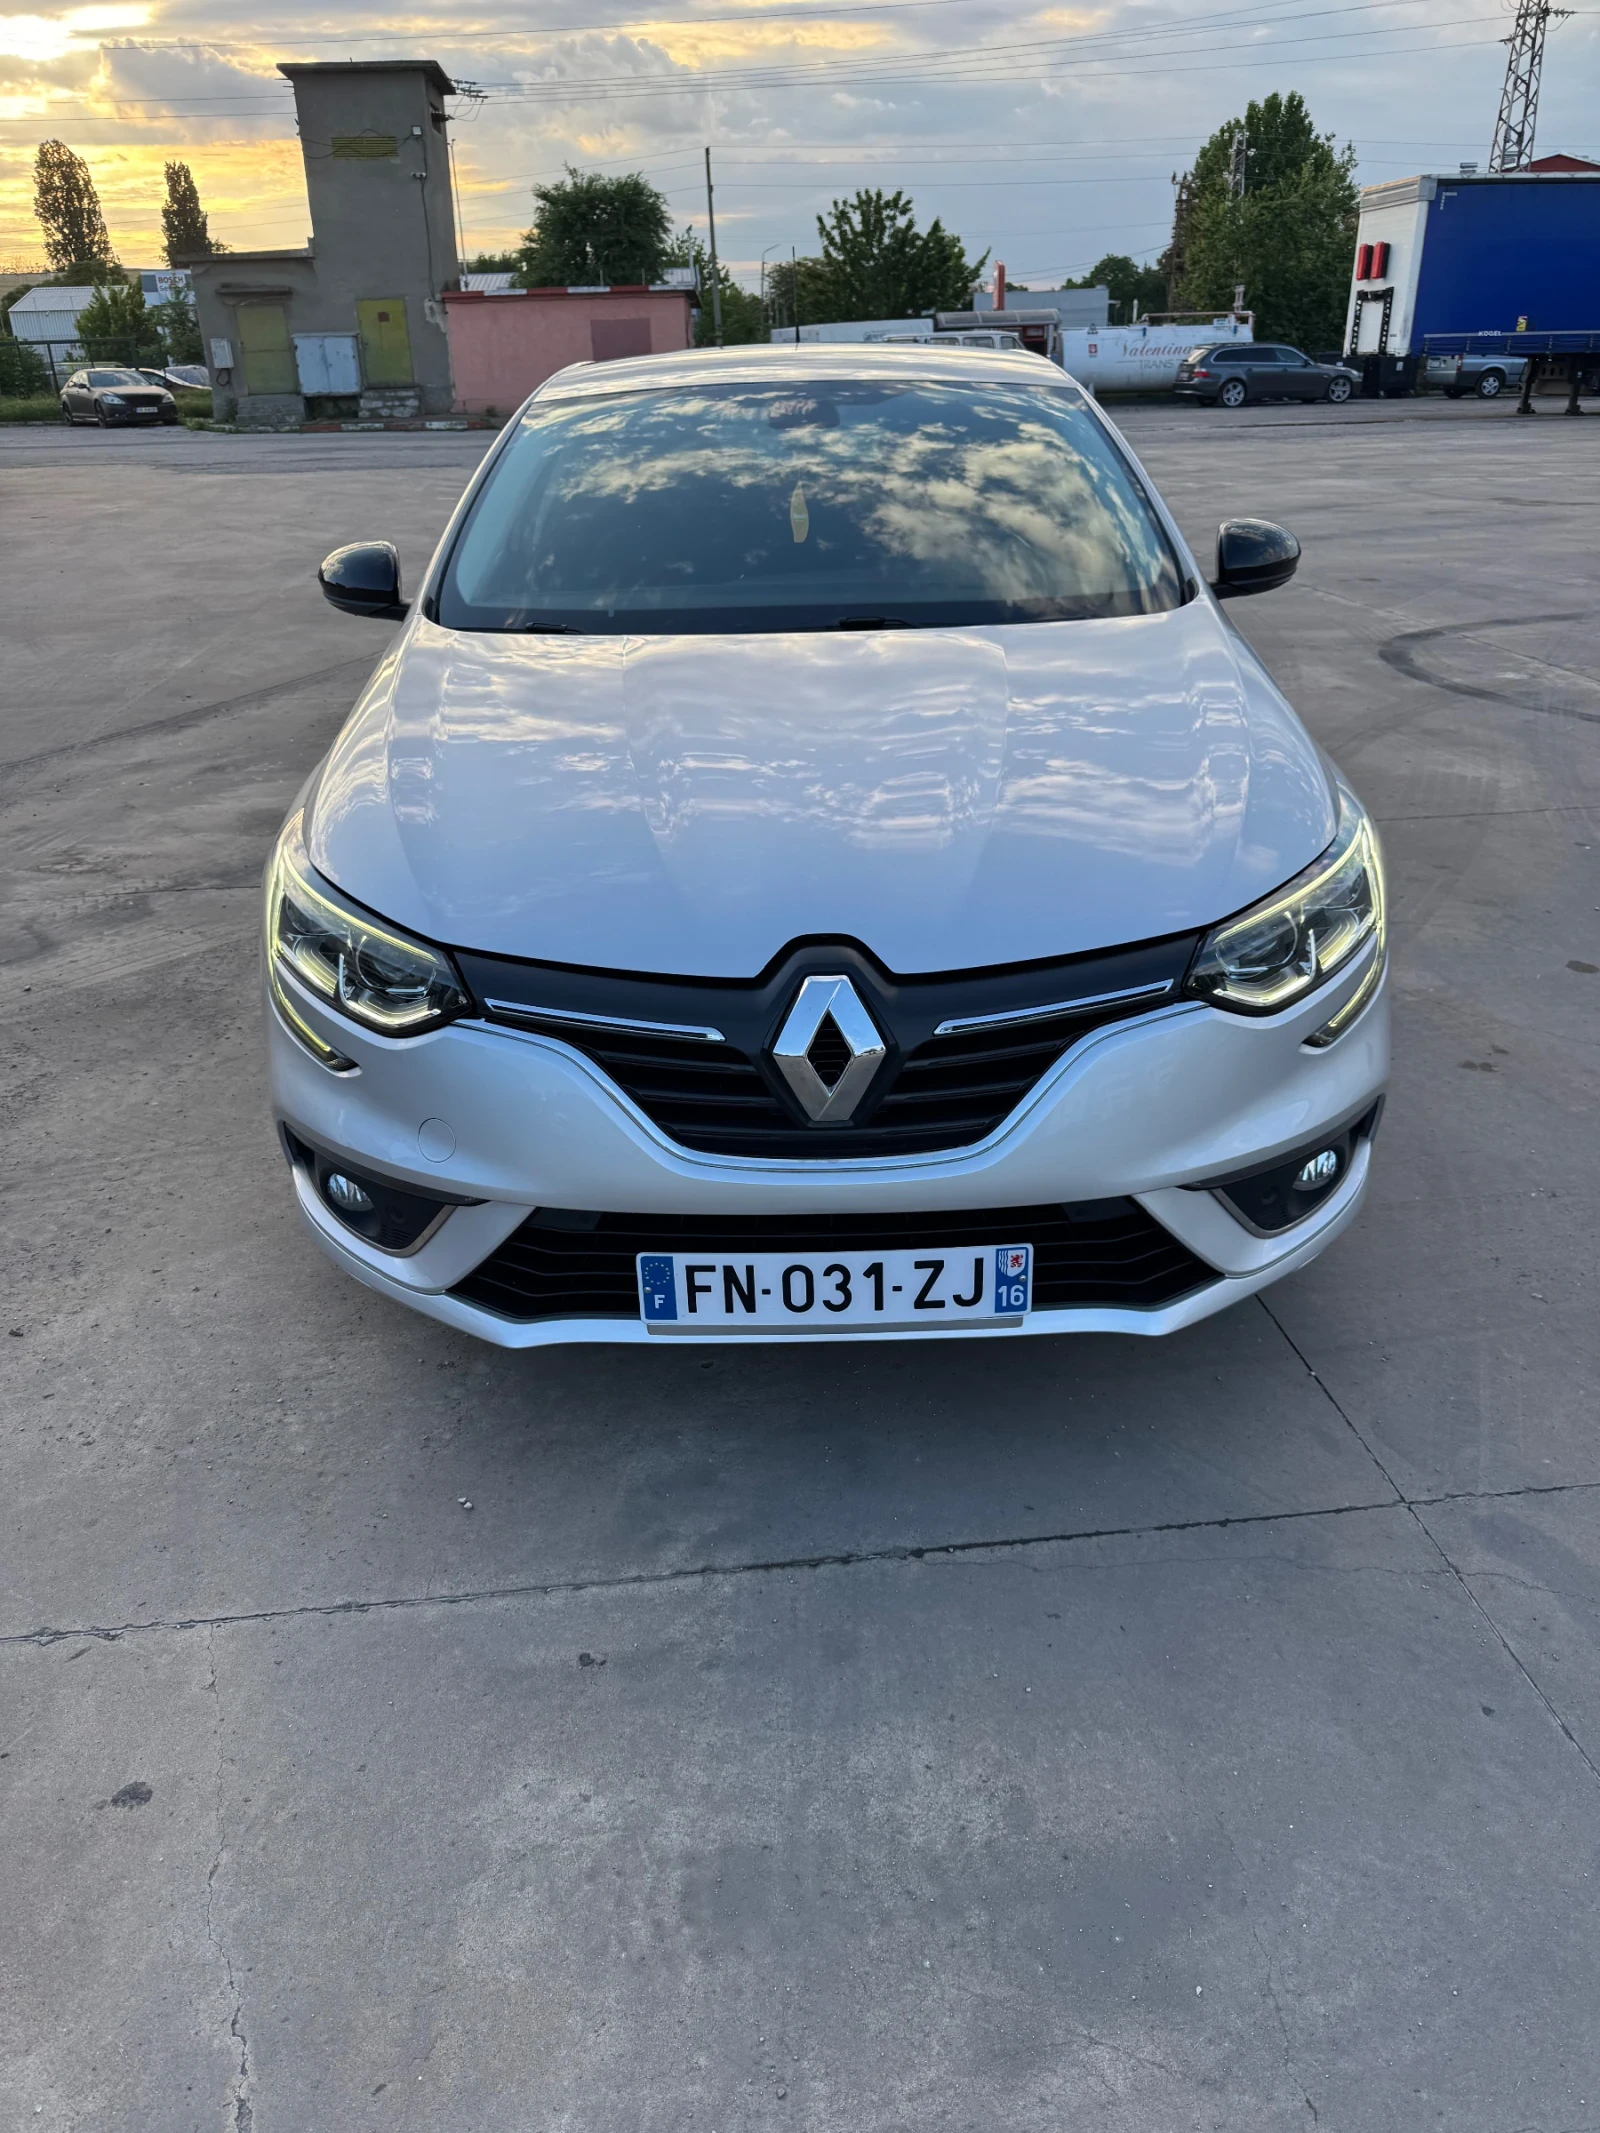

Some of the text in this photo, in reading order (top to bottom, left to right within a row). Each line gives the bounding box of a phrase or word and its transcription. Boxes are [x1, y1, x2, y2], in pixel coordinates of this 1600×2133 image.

[158, 276, 184, 284] BOSCH
[1116, 339, 1194, 357] Valentina
[1139, 359, 1174, 369] TRANS
[684, 1257, 985, 1314] FN-031-ZJ
[654, 1294, 665, 1309] F
[998, 1284, 1024, 1307] 16
